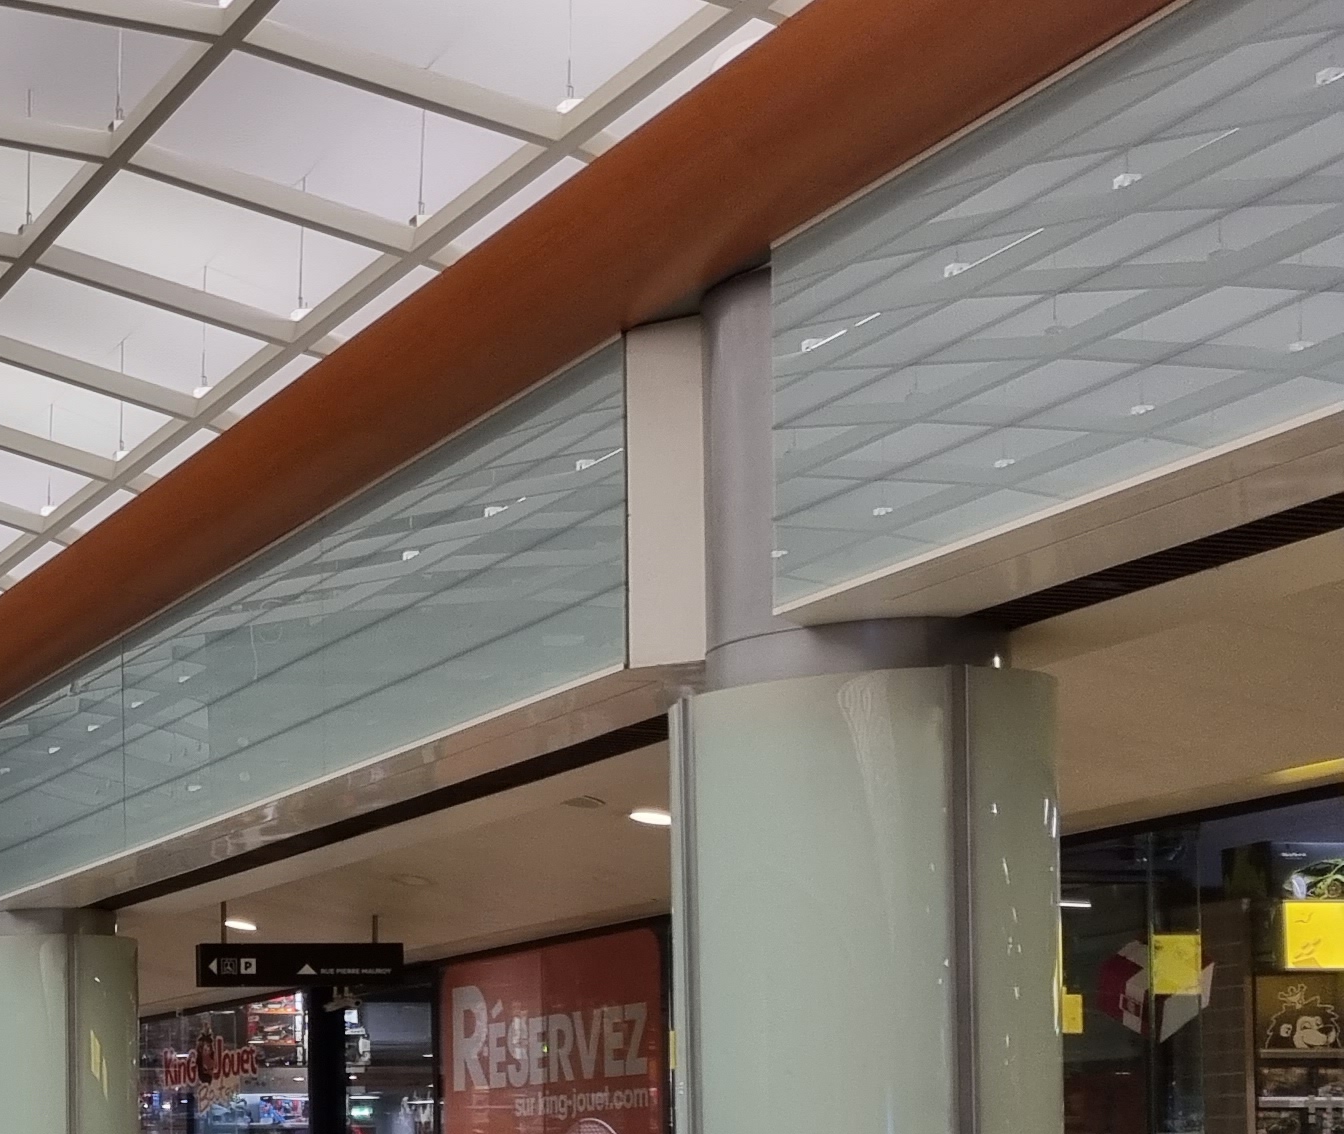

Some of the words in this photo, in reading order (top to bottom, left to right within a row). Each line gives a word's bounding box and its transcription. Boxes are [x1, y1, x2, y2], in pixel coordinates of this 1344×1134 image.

[451, 985, 648, 1092] RÉSERVEZ
[515, 1096, 537, 1117] sur
[538, 1086, 649, 1120] king-jouet.com
